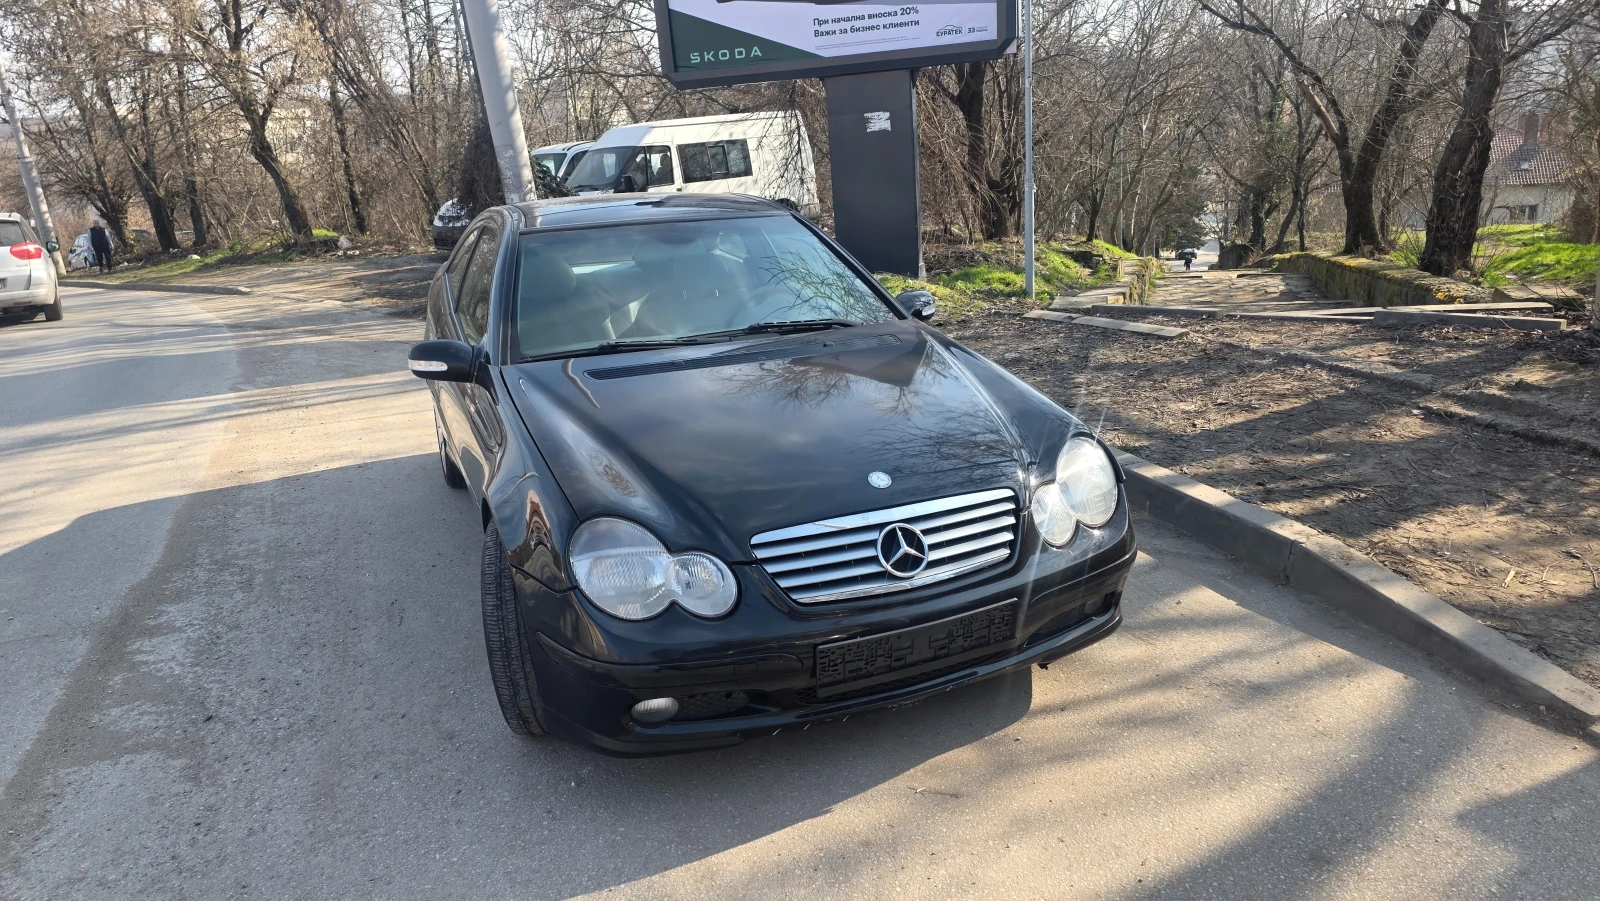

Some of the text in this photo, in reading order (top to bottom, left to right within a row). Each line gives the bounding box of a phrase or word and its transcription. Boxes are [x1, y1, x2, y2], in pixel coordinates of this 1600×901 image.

[813, 6, 919, 28] При начална вноска 20%
[813, 29, 837, 38] Важи
[849, 24, 881, 34] бизнес
[882, 19, 920, 30] клиенти
